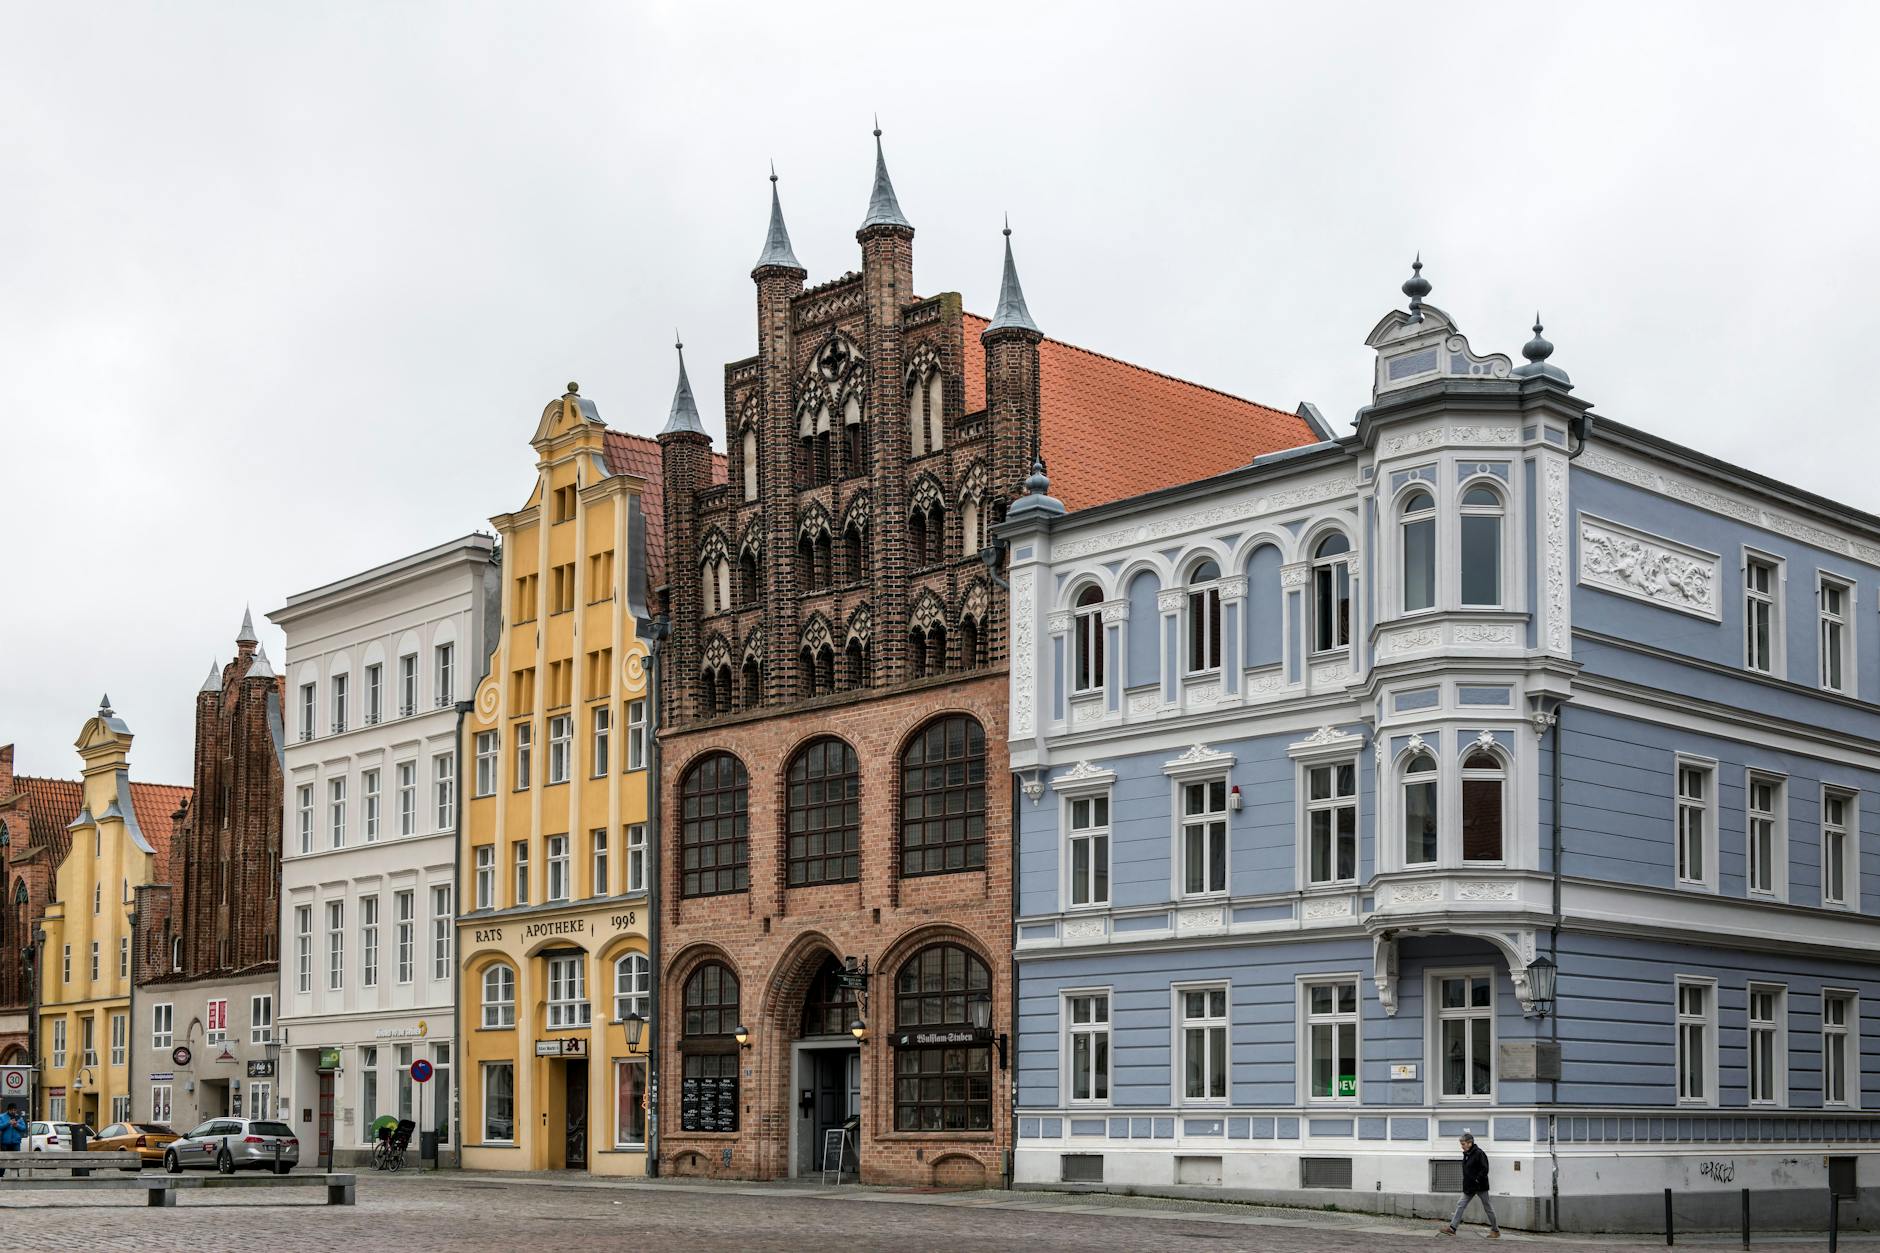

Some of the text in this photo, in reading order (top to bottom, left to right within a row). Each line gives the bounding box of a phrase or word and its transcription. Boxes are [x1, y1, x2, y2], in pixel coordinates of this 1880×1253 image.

[476, 911, 636, 943] RATS APOTHEKE 1998
[9, 1076, 20, 1084] 30
